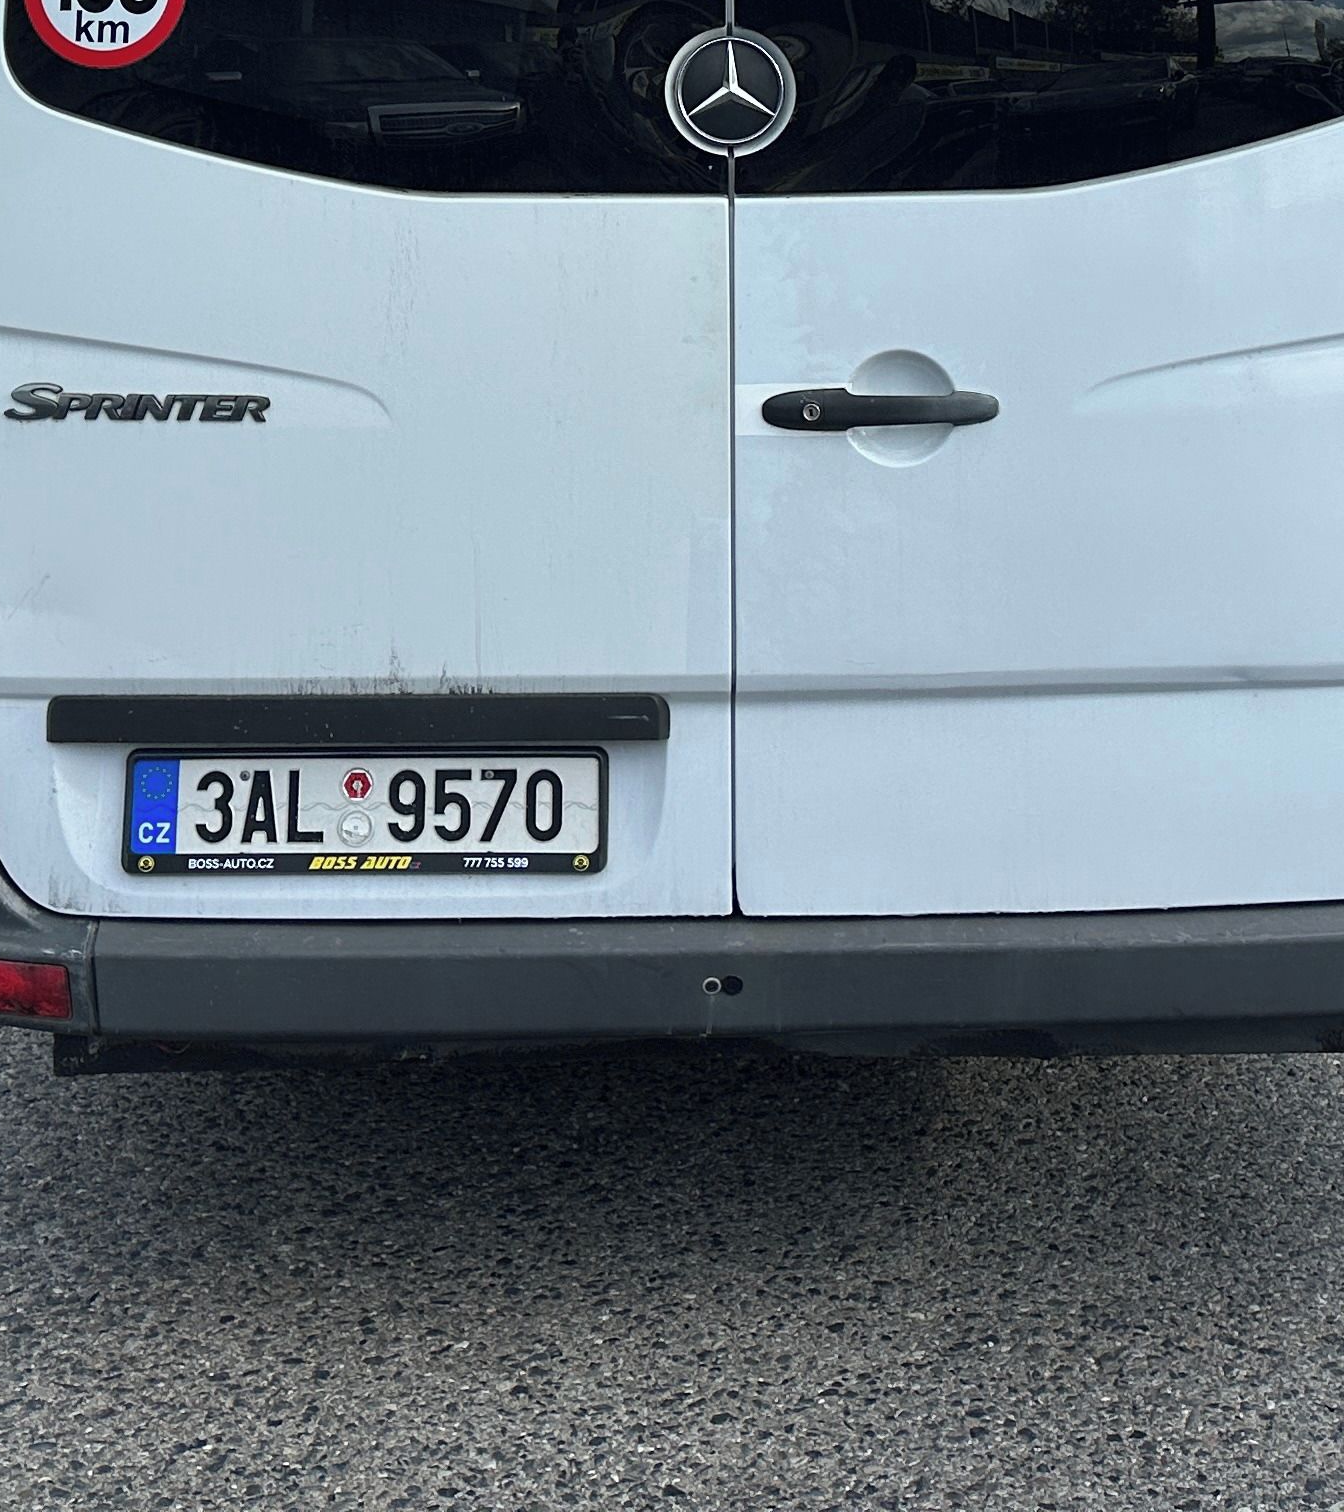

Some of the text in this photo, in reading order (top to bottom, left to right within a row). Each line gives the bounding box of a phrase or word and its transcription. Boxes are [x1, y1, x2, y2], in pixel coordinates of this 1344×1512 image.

[74, 10, 130, 44] km
[4, 382, 271, 423] SPRINTER
[138, 768, 564, 844] CZ 3AL 9570
[188, 857, 275, 869] BOSS-AUTO.CZ
[308, 856, 358, 870] BOSS
[359, 856, 413, 870] AUTO
[462, 857, 483, 868] 777
[484, 857, 505, 868] 755
[506, 857, 529, 868] 599
